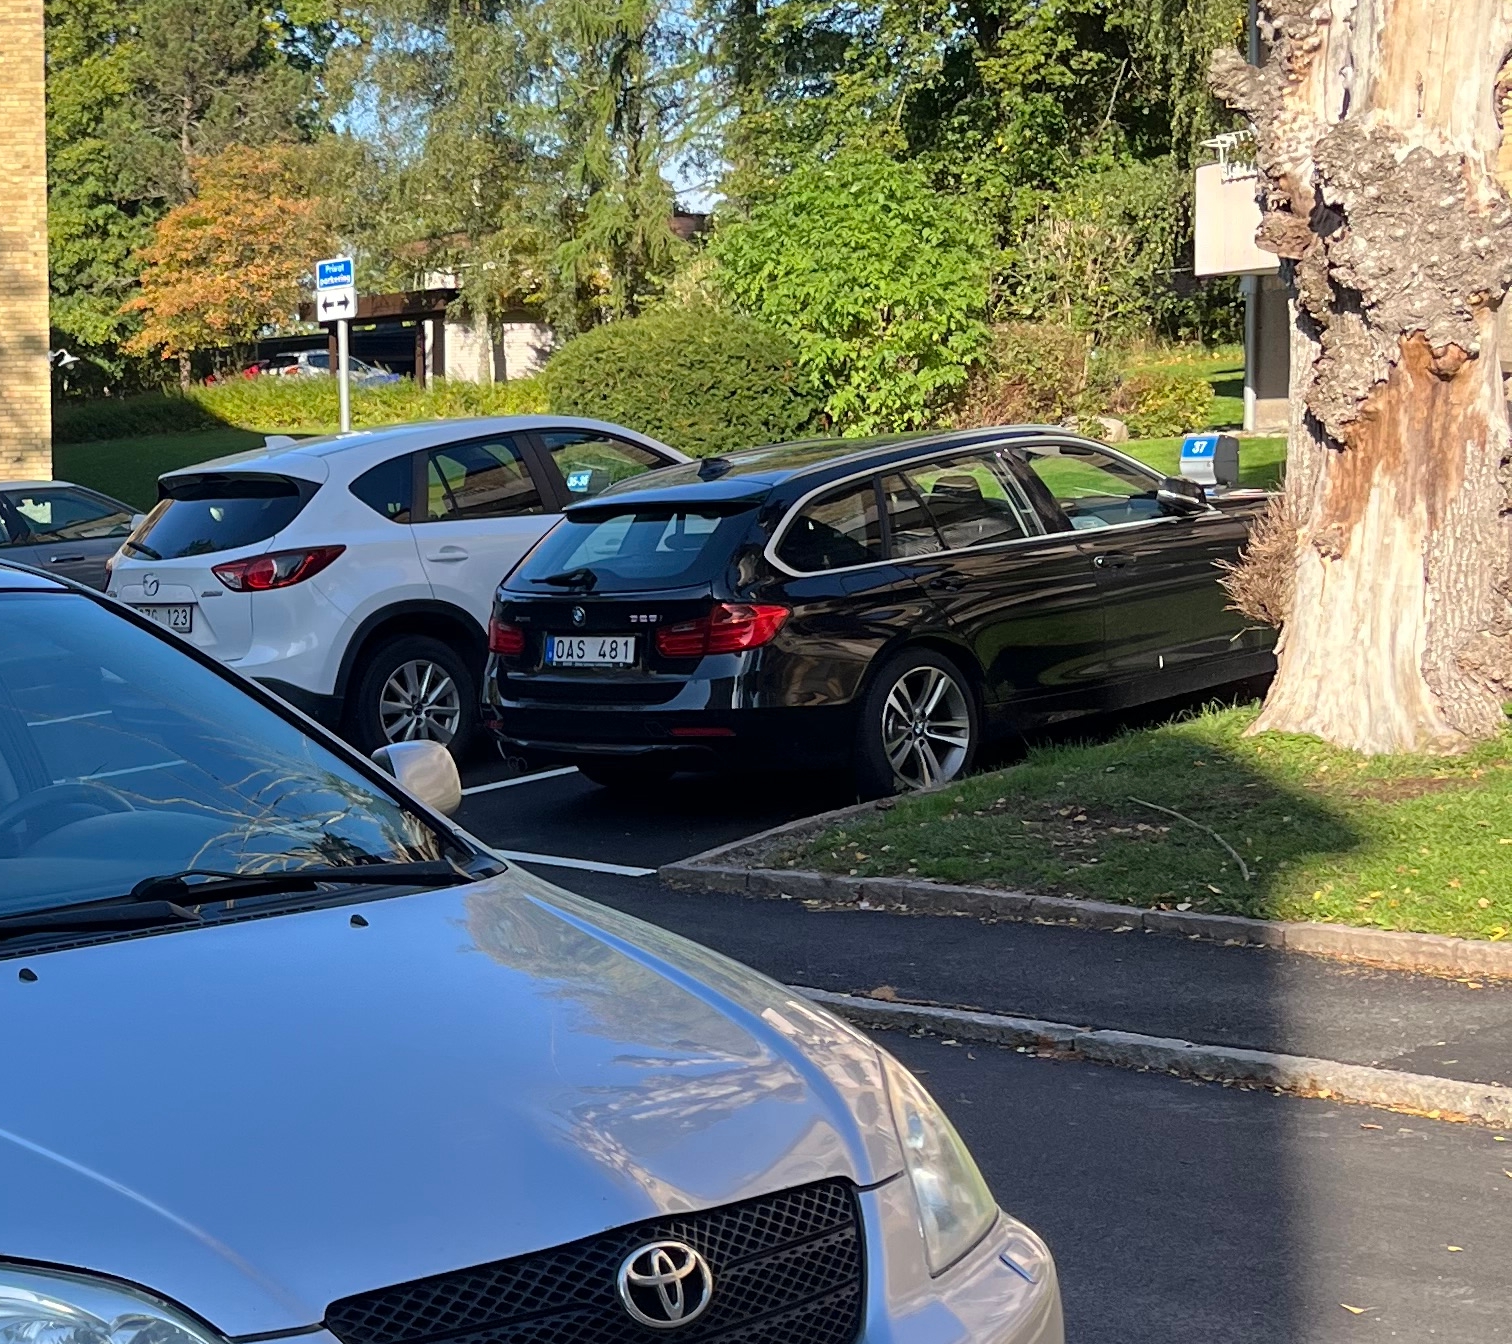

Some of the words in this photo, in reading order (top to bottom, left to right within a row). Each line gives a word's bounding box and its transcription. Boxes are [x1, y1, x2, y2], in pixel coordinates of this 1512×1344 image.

[324, 263, 345, 274] Privat
[319, 273, 350, 286] parkering
[1191, 440, 1208, 454] 37
[167, 608, 189, 626] 123
[555, 639, 586, 659] OAS
[598, 639, 629, 660] 481
